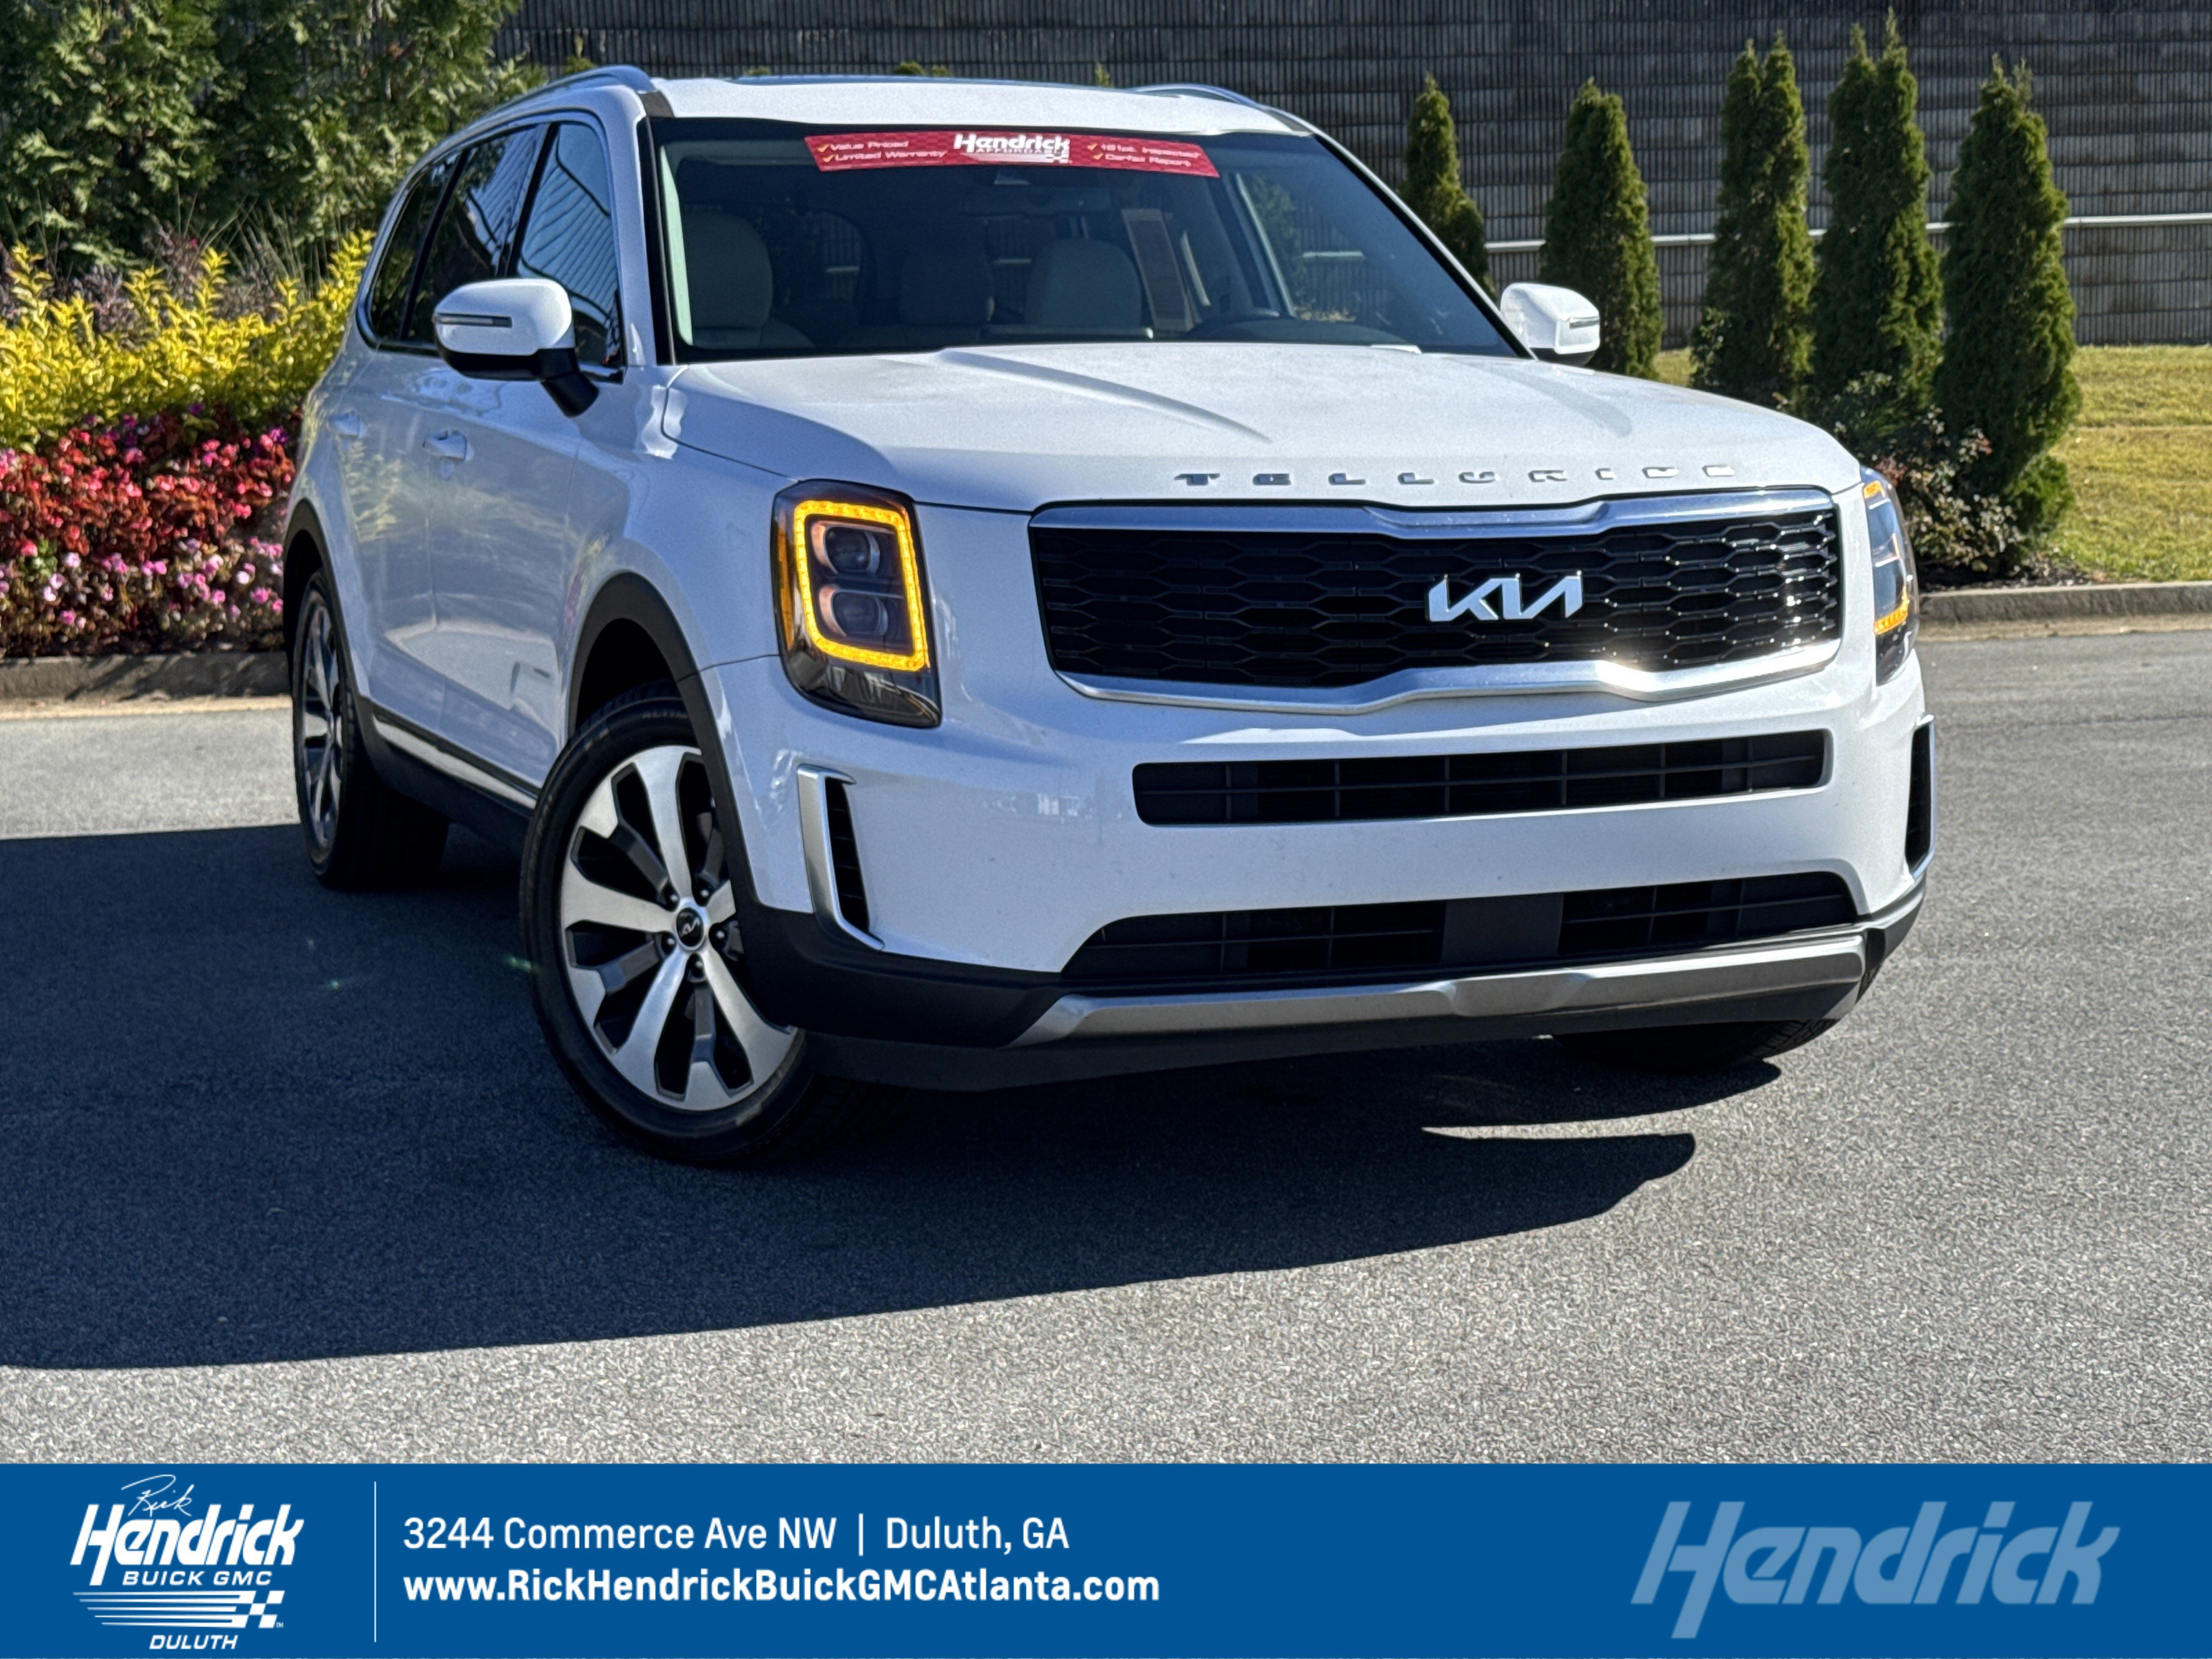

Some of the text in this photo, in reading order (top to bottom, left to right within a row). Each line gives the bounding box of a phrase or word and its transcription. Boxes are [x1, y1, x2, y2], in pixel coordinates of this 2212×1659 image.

[953, 133, 1070, 153] Hendrick
[835, 149, 948, 161] Limited Warranty
[1429, 575, 1582, 622] KIA
